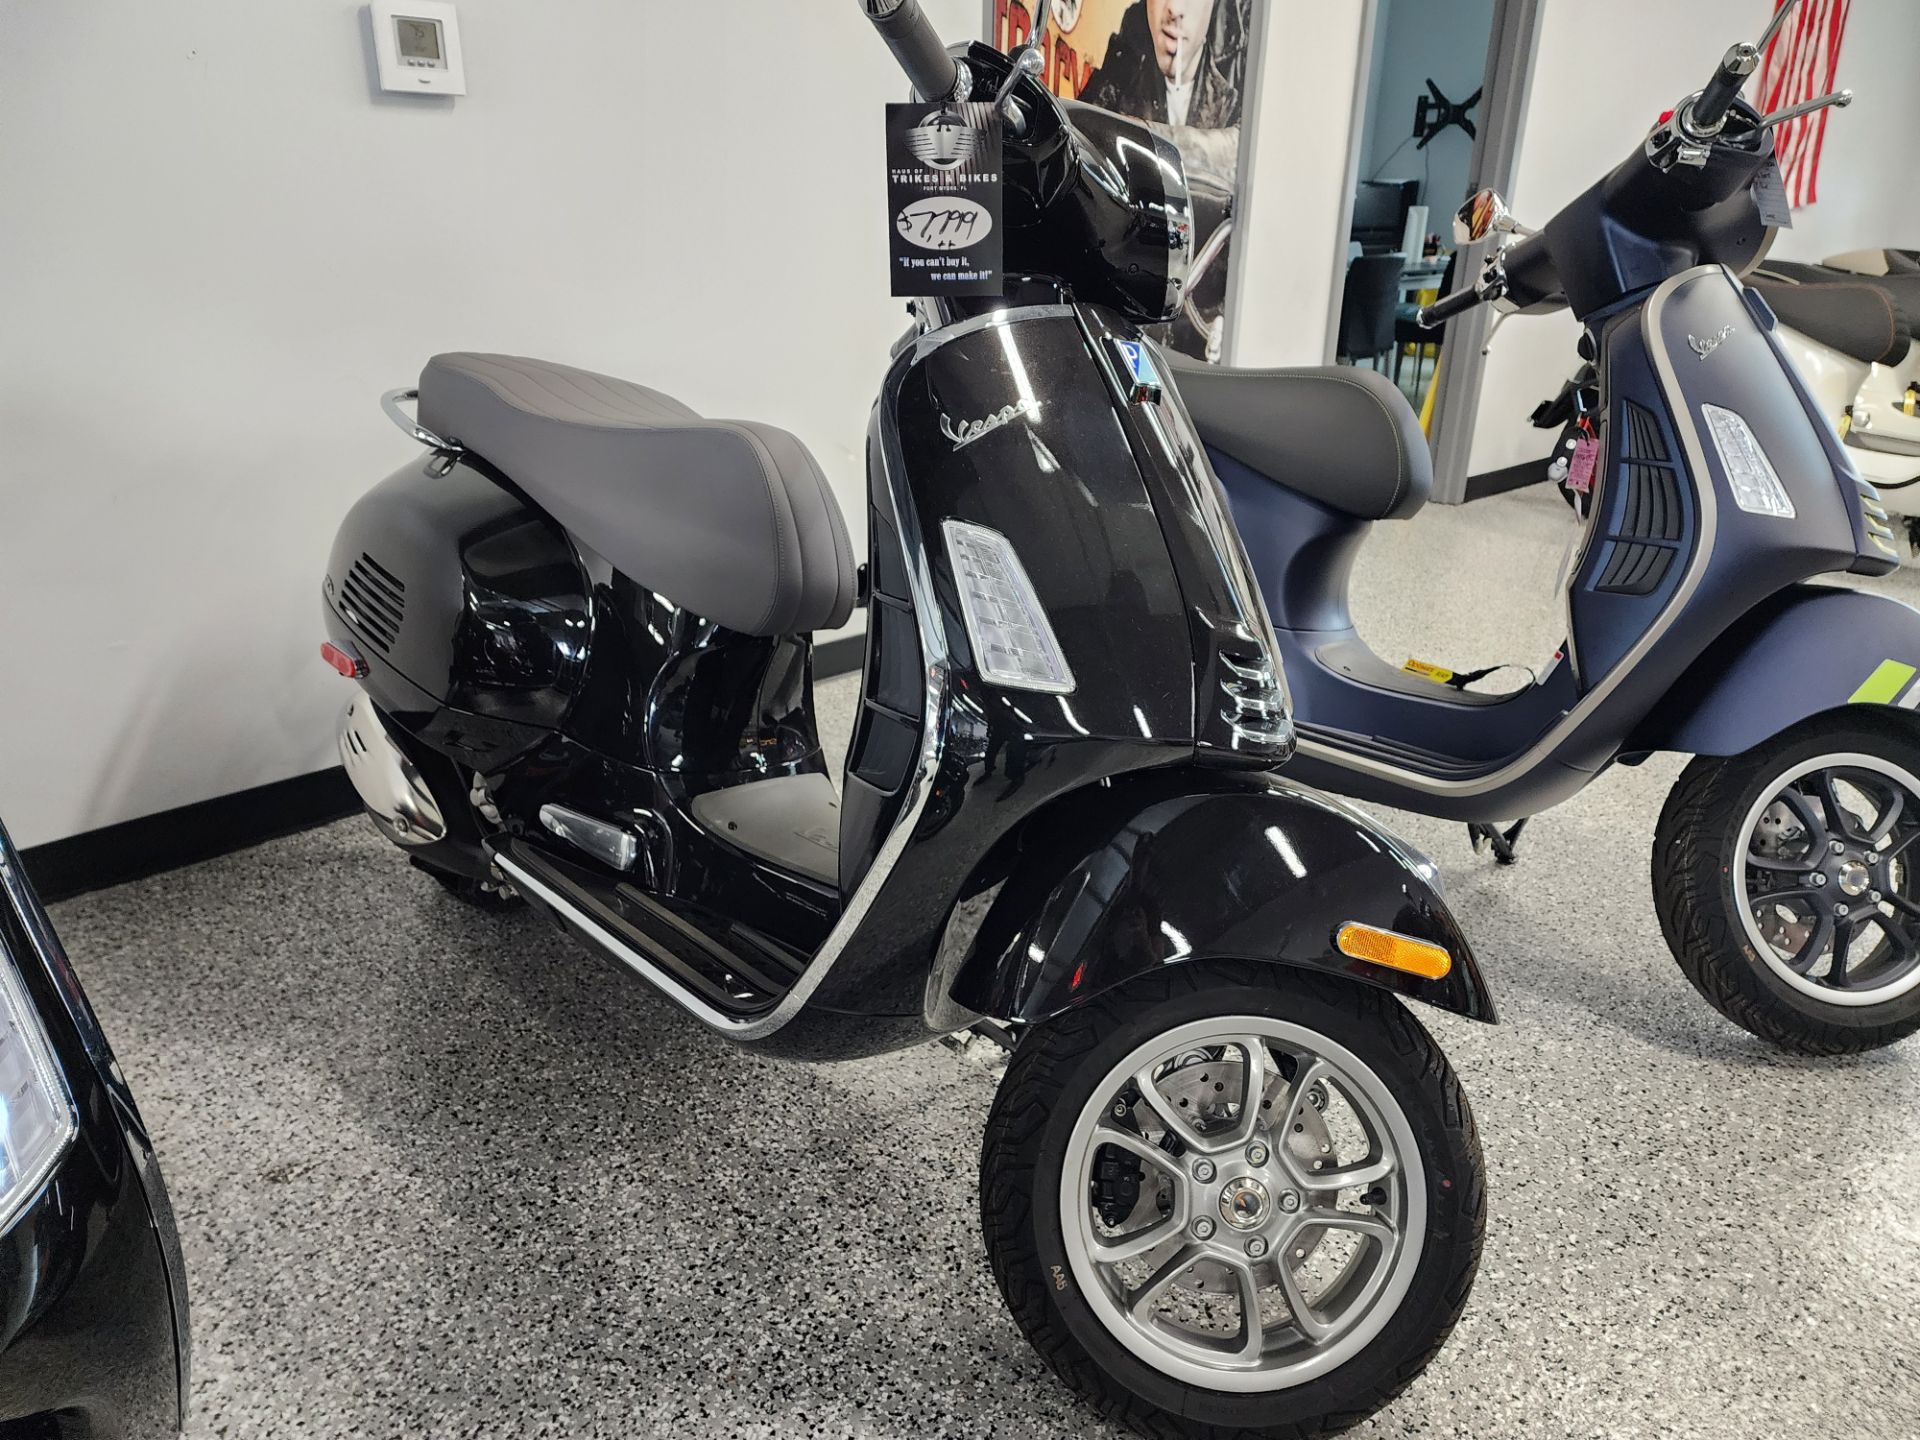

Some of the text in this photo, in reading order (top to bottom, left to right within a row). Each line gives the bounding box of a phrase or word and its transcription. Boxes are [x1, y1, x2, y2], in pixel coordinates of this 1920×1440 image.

[892, 175, 939, 183] TRIKES
[959, 174, 998, 183] BIKES
[911, 258, 925, 268] you
[926, 256, 945, 267] can't
[946, 256, 960, 268] buy
[957, 270, 978, 280] make
